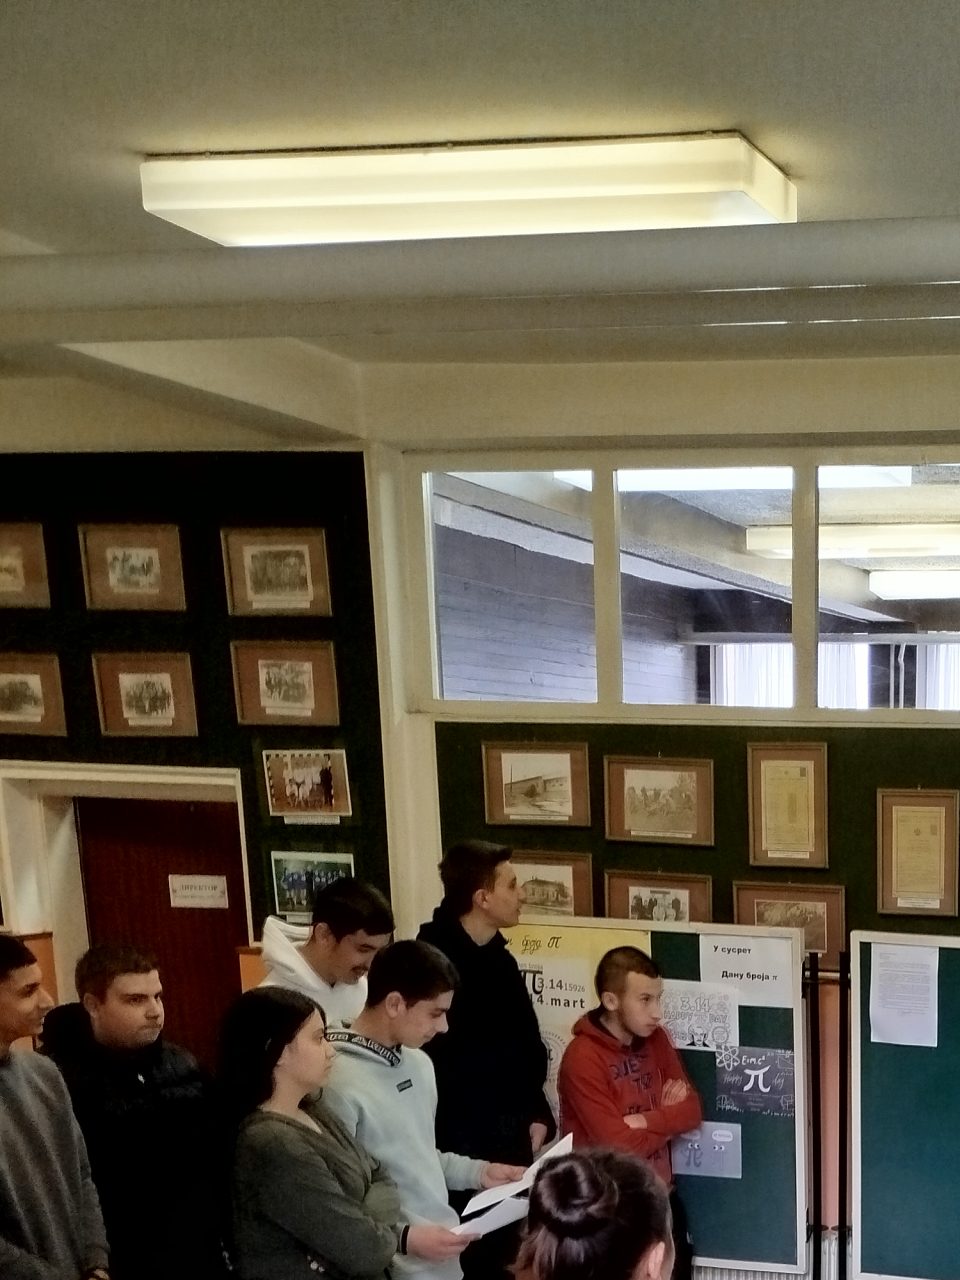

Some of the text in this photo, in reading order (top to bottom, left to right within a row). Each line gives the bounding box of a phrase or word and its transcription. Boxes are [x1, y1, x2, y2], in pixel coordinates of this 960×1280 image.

[721, 945, 752, 955] сусрет
[721, 970, 744, 980] Дану
[746, 971, 770, 981] броја
[680, 996, 711, 1013] 3.14
